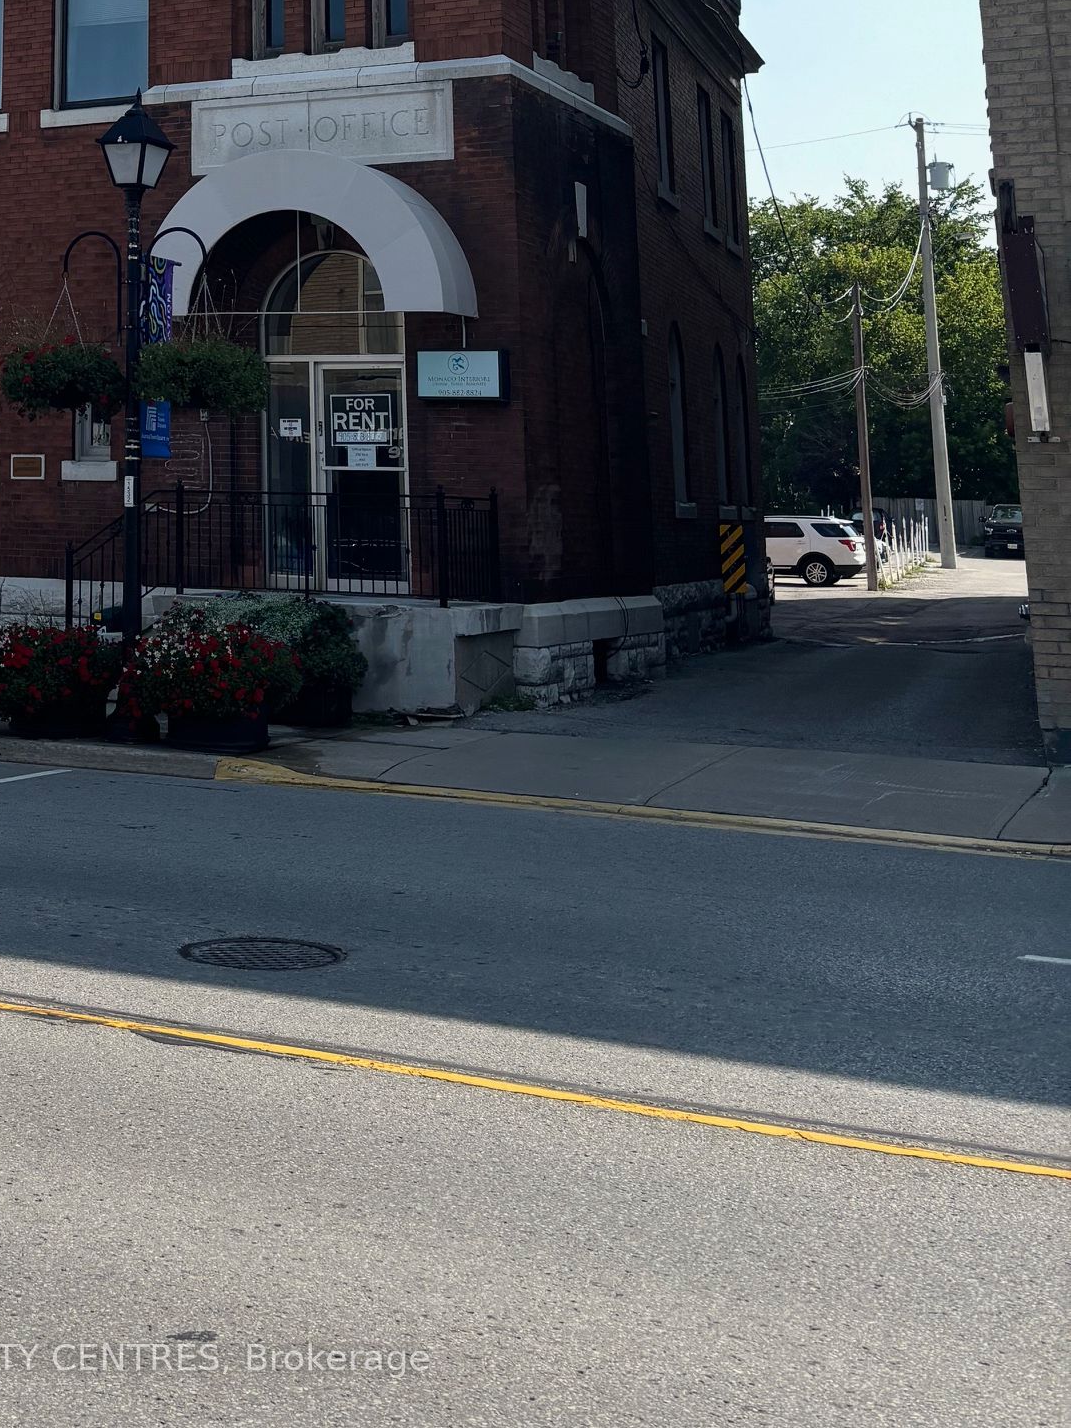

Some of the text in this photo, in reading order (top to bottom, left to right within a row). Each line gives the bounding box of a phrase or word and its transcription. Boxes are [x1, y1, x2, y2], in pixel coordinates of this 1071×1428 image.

[212, 108, 429, 148] POST OFFICE
[345, 398, 375, 410] FOR
[333, 412, 389, 430] RENT
